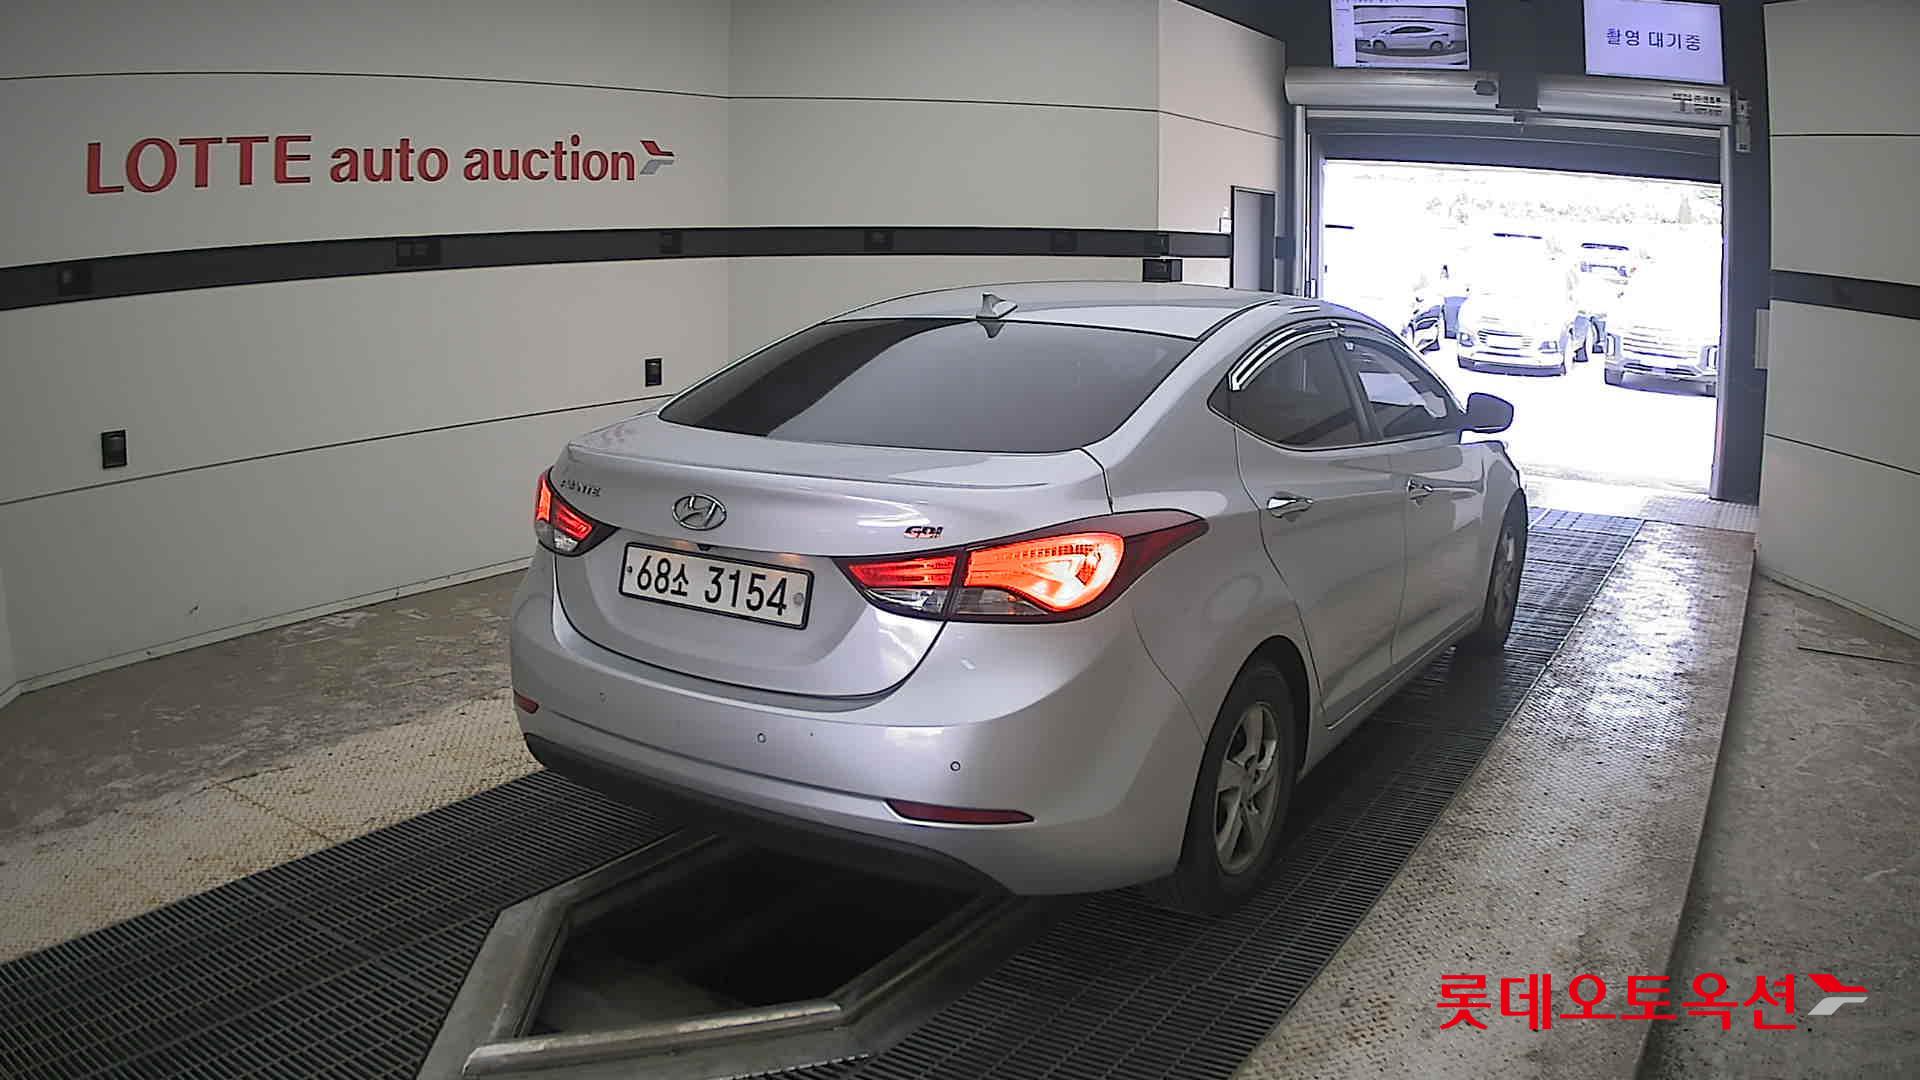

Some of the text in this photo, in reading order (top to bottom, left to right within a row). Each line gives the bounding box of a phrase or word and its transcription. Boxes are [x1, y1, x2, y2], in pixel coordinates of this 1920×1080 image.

[1607, 28, 1701, 52] 촬영 대기중
[86, 134, 637, 194] LOTTE auto auction
[637, 555, 788, 616] 68소 3154
